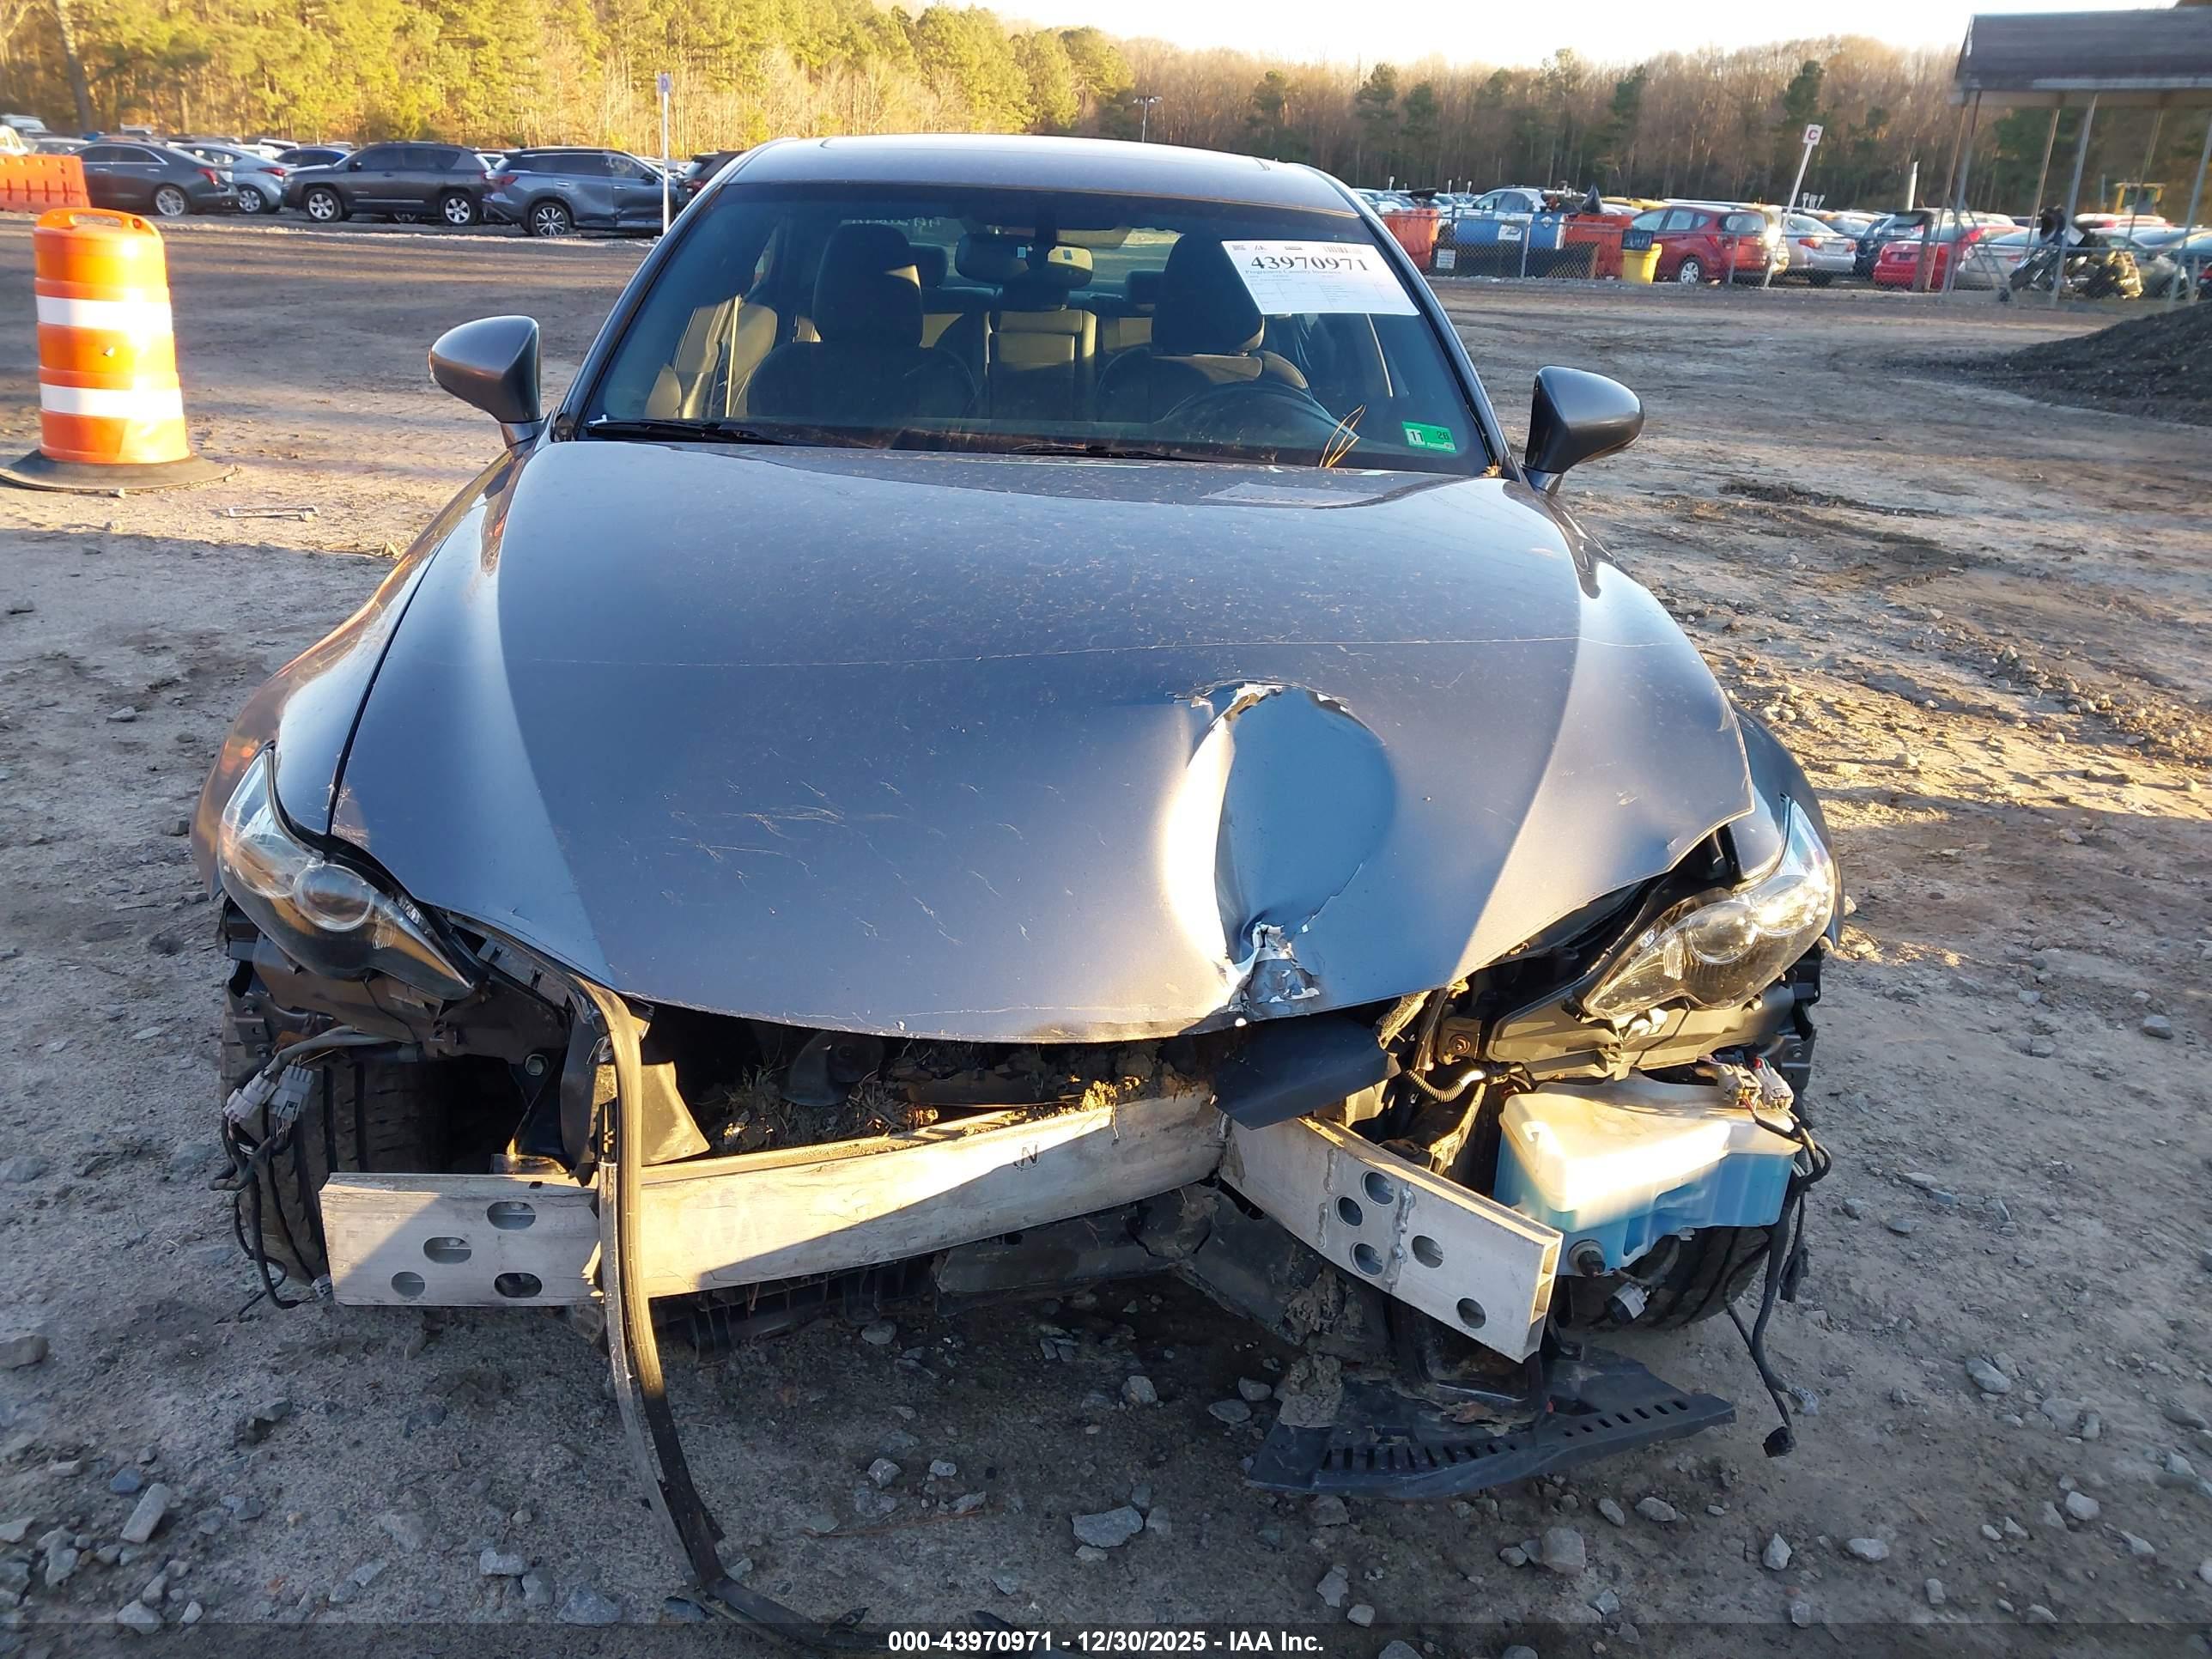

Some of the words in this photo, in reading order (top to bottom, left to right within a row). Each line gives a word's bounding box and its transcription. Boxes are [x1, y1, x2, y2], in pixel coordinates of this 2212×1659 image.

[1808, 129, 1819, 141] C
[1251, 256, 1370, 271] 43970971
[1410, 431, 1424, 442] 11
[1020, 1144, 1039, 1167] N
